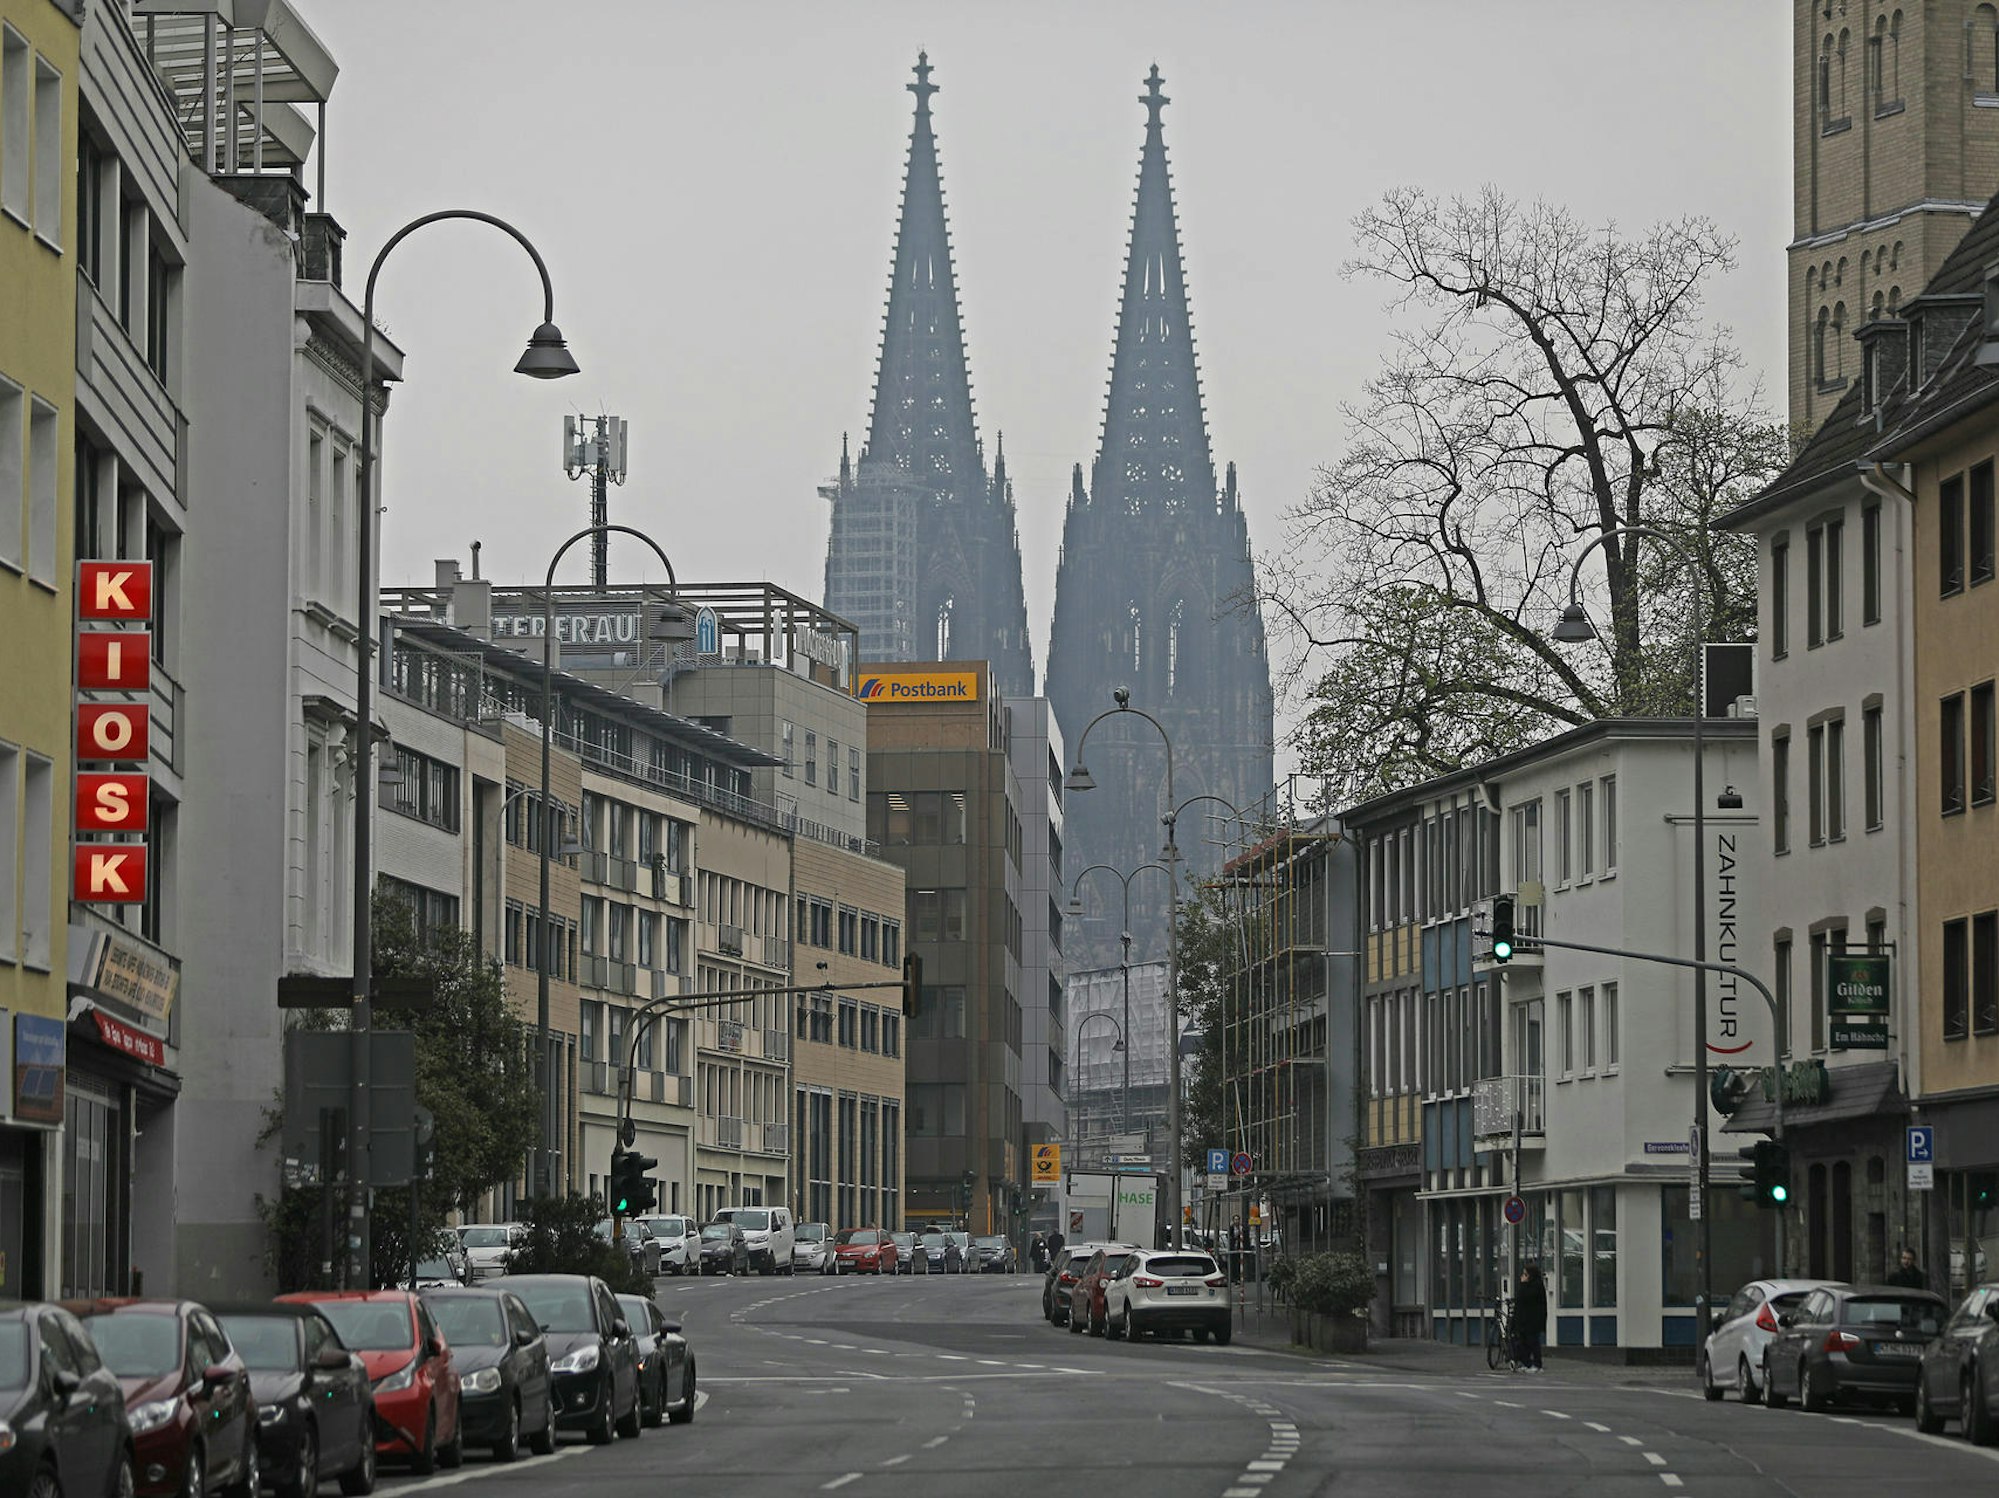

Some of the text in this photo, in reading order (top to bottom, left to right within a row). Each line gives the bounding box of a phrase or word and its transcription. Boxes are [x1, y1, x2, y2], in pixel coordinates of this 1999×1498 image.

[891, 680, 967, 697] Postbank
[89, 571, 135, 894] KIOSK
[1836, 982, 1883, 997] Gilden
[1835, 1031, 1849, 1042] Em
[1910, 1130, 1925, 1158] P
[1212, 1152, 1224, 1170] P
[1119, 1192, 1154, 1204] HASE
